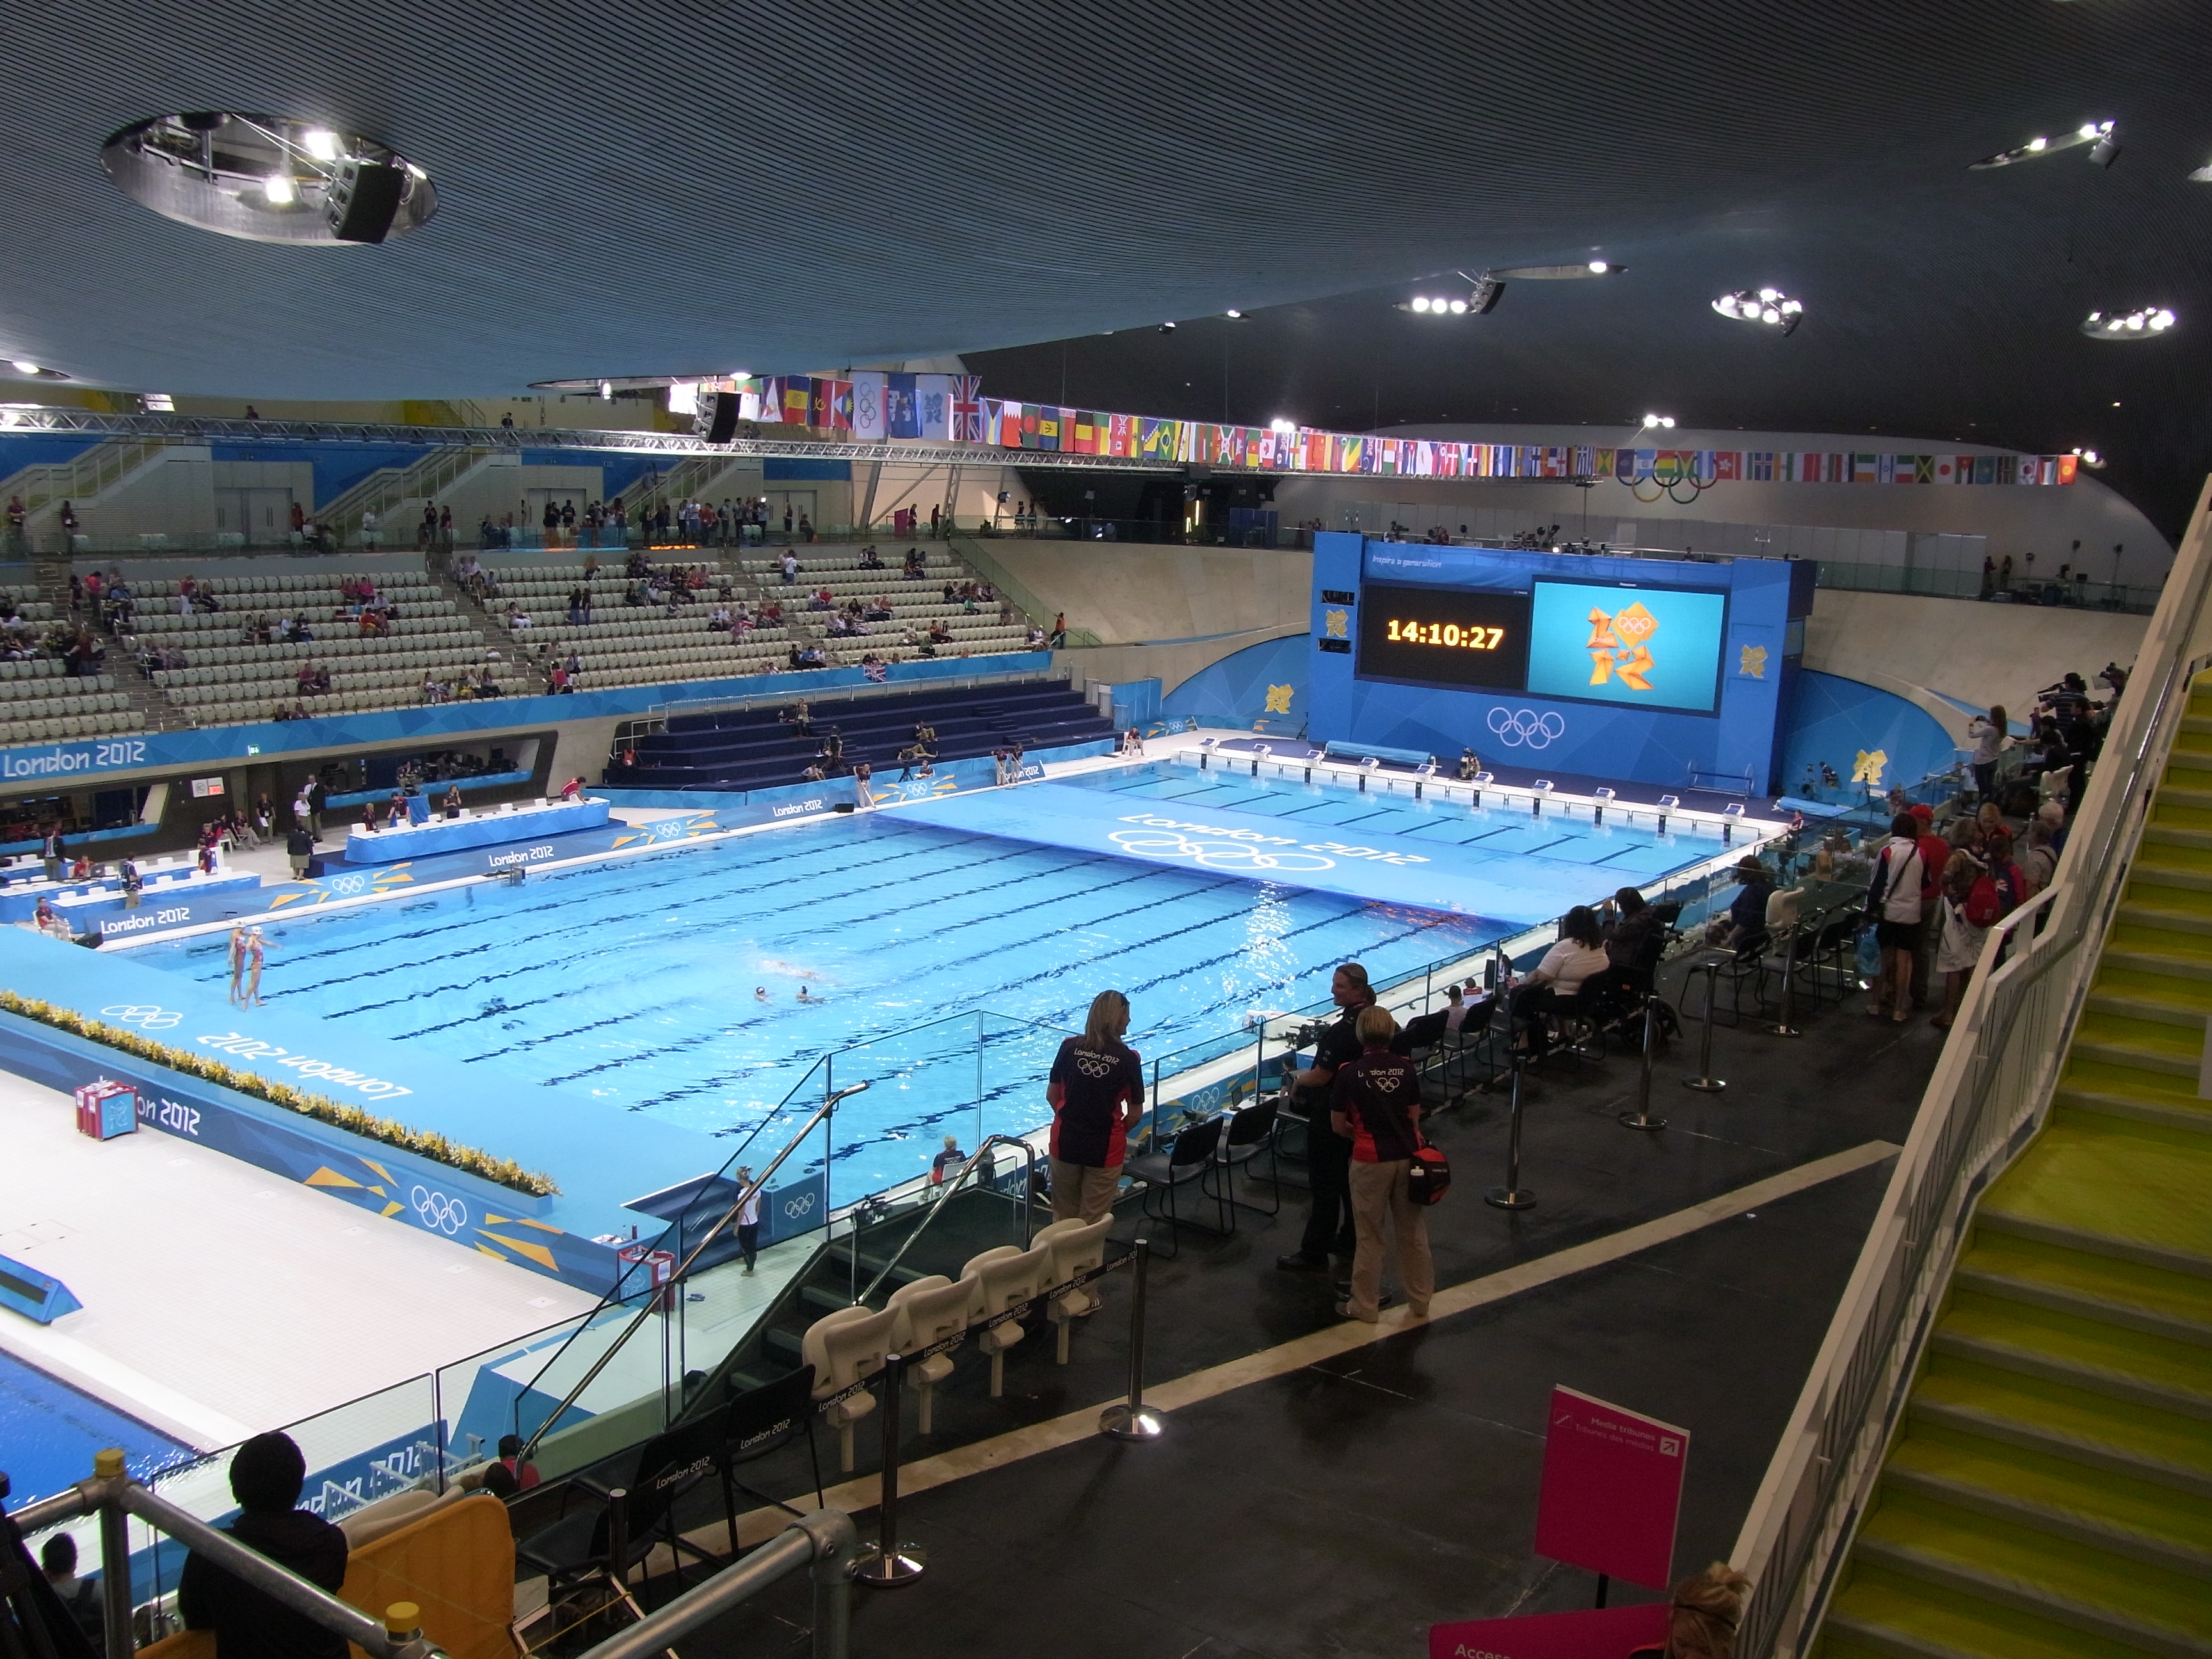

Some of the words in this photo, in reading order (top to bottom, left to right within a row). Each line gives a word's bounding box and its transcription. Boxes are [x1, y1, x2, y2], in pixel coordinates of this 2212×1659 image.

[1388, 620, 1503, 650] 14:10:27
[4, 748, 90, 777] London
[96, 741, 145, 766] 2012
[773, 803, 804, 817] London
[803, 799, 823, 811] 2012
[1118, 813, 1298, 846] London
[1301, 842, 1431, 865] 2012
[488, 851, 529, 867] London
[529, 846, 554, 859] 2012
[100, 915, 154, 934] London
[157, 907, 190, 924] 2012
[196, 1032, 288, 1060] 2012
[1074, 1047, 1101, 1059] London
[1102, 1054, 1120, 1065] 2012
[277, 1055, 413, 1100] London
[160, 1098, 200, 1135] 2012
[1107, 1256, 1127, 1272] London
[1128, 1249, 1137, 1262] 201
[1050, 1283, 1072, 1299] London
[1073, 1276, 1087, 1290] 2012
[989, 1311, 1013, 1328] London
[1013, 1302, 1029, 1317] 2012
[924, 1342, 950, 1358] London
[950, 1331, 966, 1345] 2012
[819, 1393, 847, 1412] London
[848, 1381, 865, 1399] 2012
[741, 1429, 770, 1450] London
[772, 1418, 790, 1434] 2012
[1575, 1423, 1607, 1439] Tribunes
[1609, 1434, 1624, 1443] des
[1591, 1417, 1617, 1431] Media
[1619, 1426, 1656, 1441] tribunes
[656, 1469, 688, 1490] London
[690, 1456, 710, 1473] 2012
